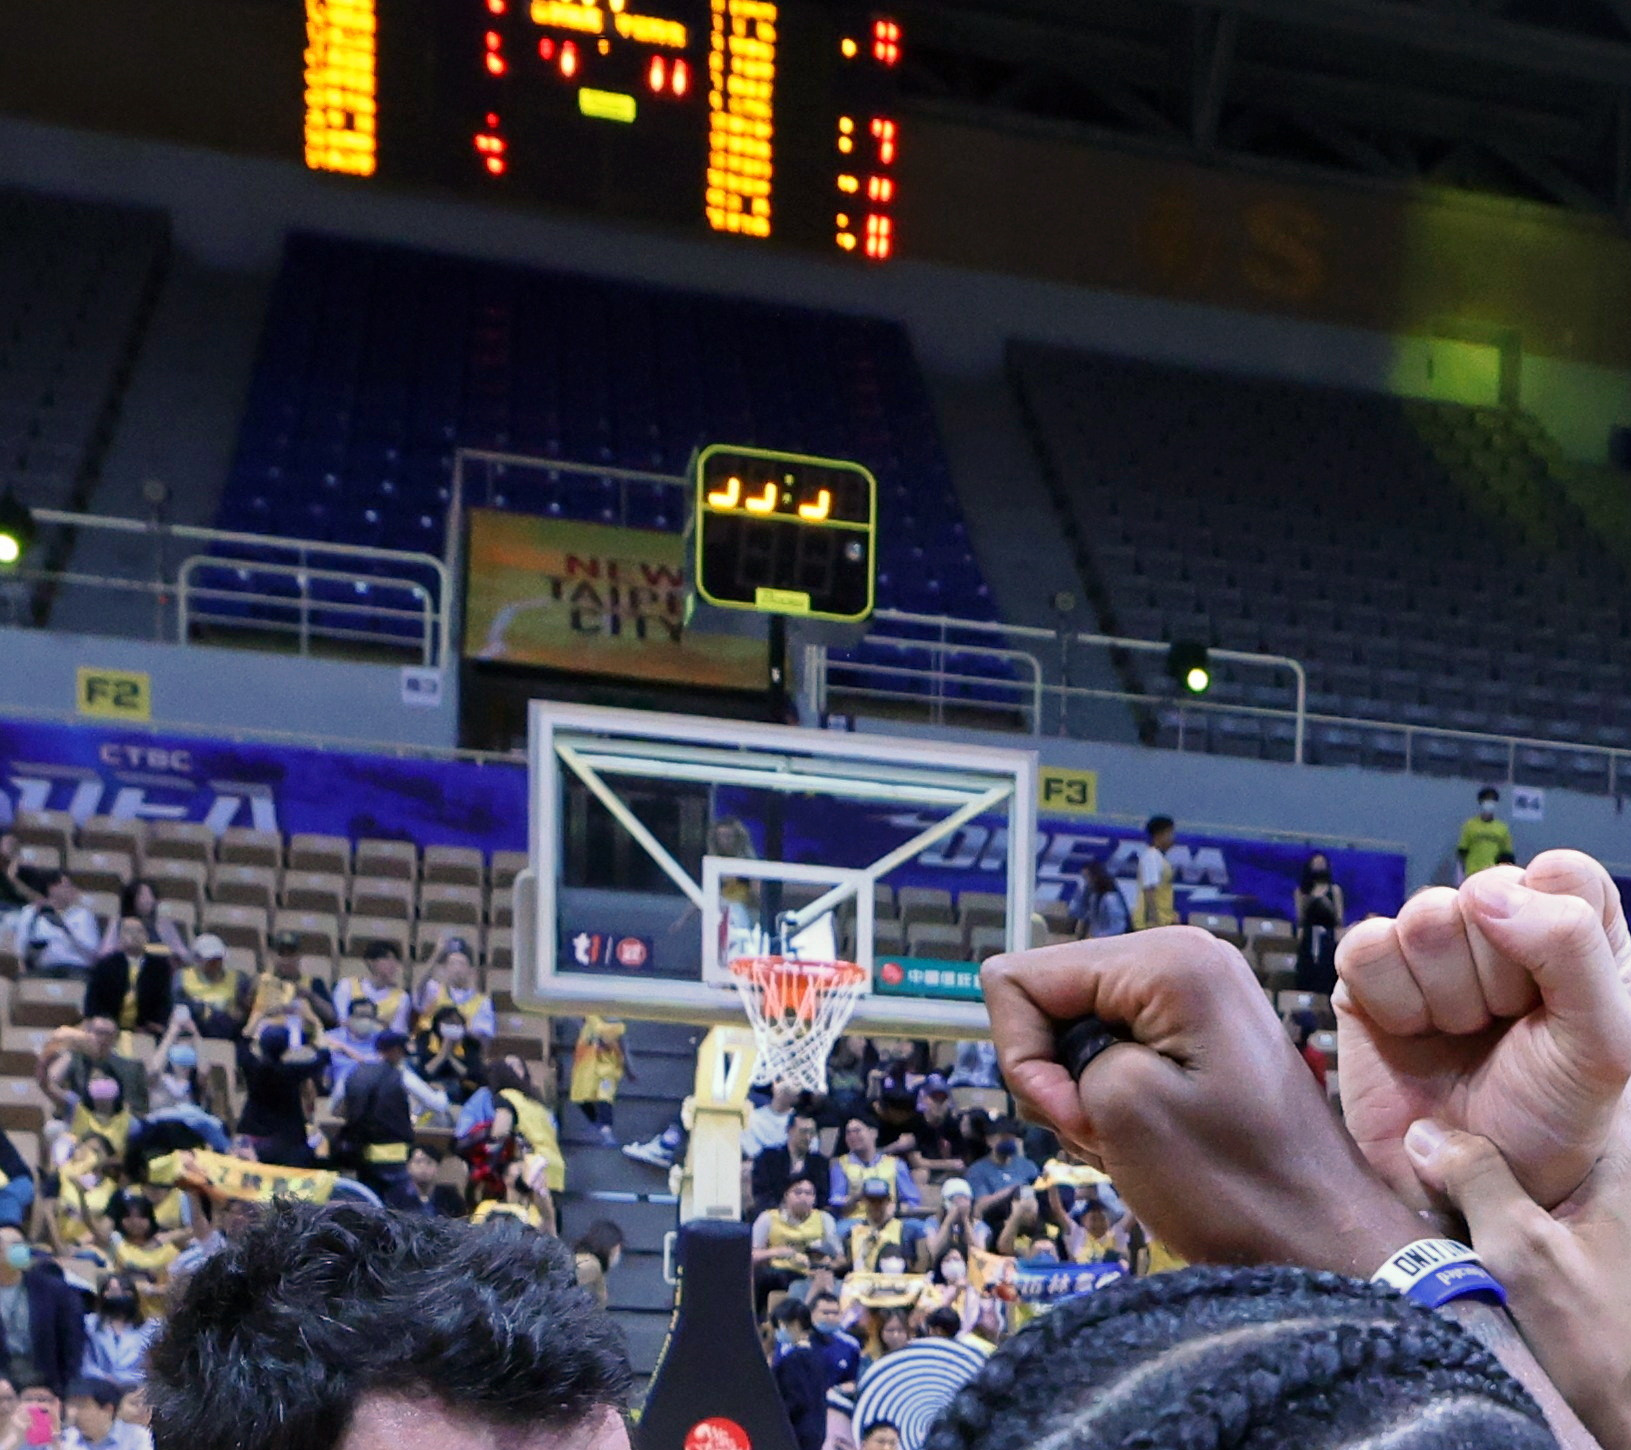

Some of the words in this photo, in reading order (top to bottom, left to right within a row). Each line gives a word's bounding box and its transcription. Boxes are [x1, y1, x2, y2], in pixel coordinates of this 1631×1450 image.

[85, 676, 140, 708] F2
[98, 742, 194, 772] CTBC
[1043, 778, 1088, 805] F3
